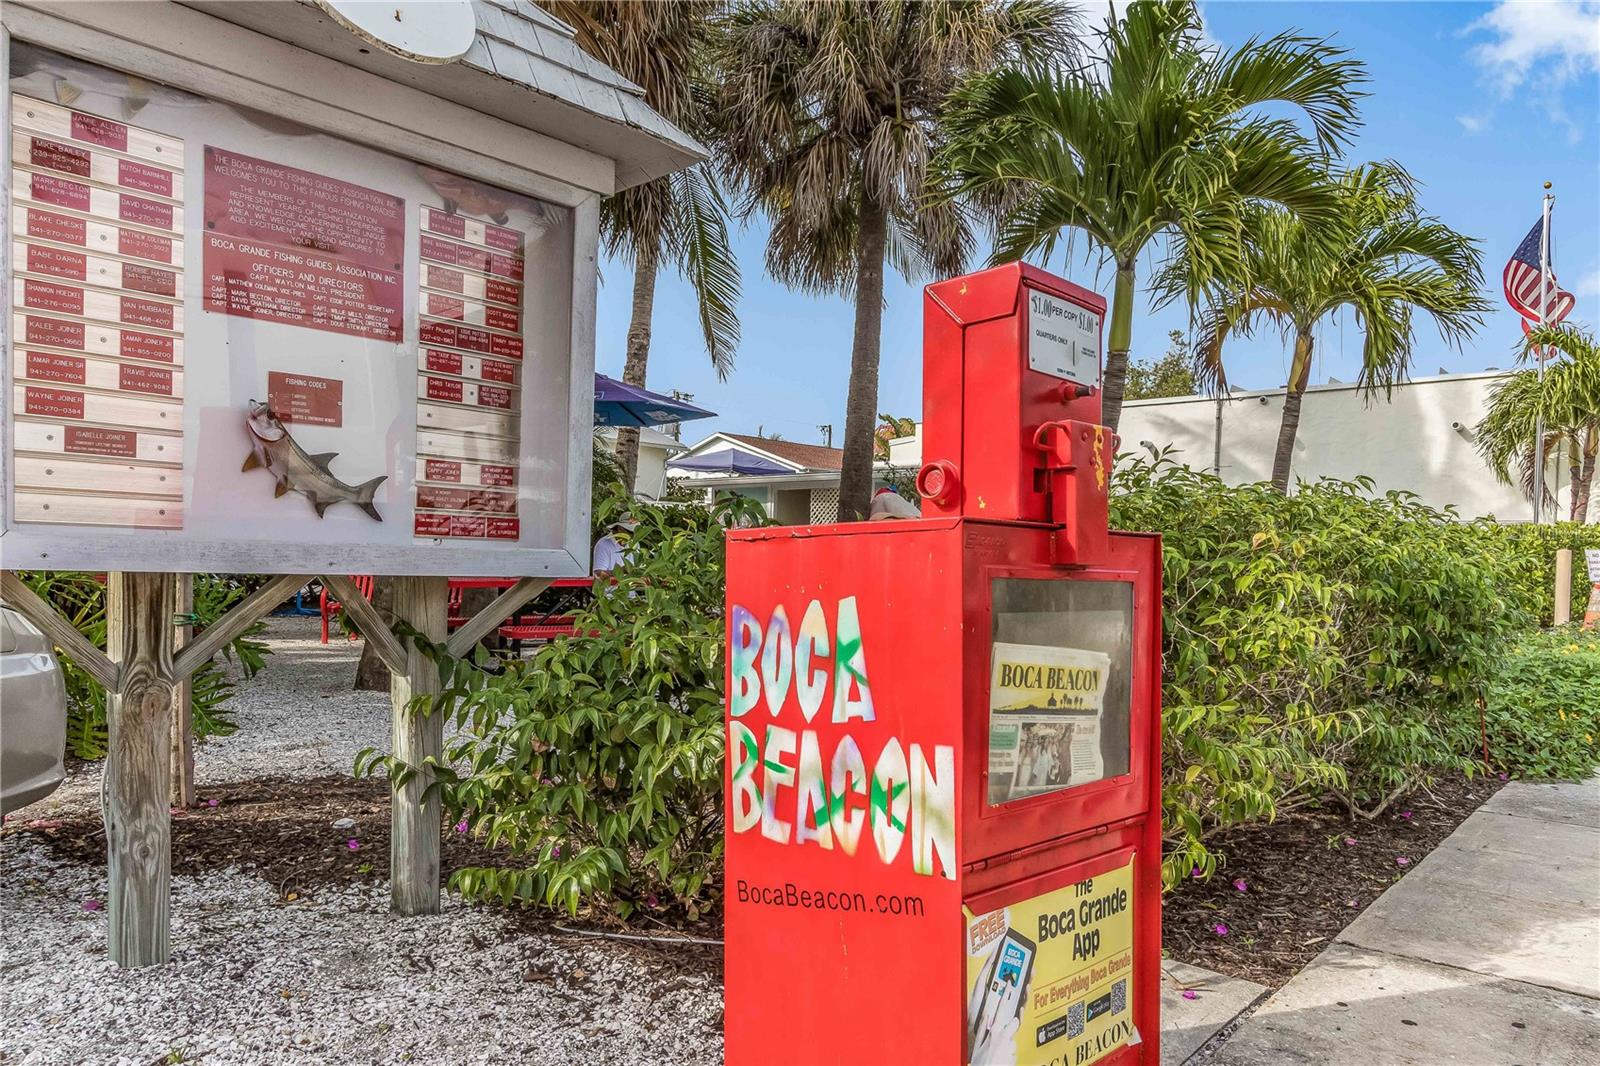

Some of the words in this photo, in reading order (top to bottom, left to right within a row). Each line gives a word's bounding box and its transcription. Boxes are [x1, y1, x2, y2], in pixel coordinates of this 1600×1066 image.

[33, 176, 56, 186] MARK
[59, 181, 89, 193] BECTON
[215, 155, 229, 165] THE
[231, 159, 253, 172] BOCA
[256, 165, 284, 179] GRANDE
[287, 173, 313, 187] FISHING
[214, 165, 257, 182] WELCOMES
[261, 178, 276, 187] YOU
[279, 181, 290, 190] TO
[292, 184, 308, 195] THIS
[310, 188, 338, 202] FAMOUS
[341, 197, 364, 209] FISHING
[121, 199, 140, 208] DAVID
[228, 198, 244, 208] AND
[247, 202, 296, 220] KNOWLEDGE
[298, 214, 343, 231] CONCERNING
[229, 190, 274, 206] REPRESENT
[279, 203, 302, 214] YEARS
[305, 208, 314, 216] OF
[318, 212, 343, 223] FISHING
[346, 219, 384, 233] EXPERIENCE
[240, 185, 254, 194] THE
[257, 190, 294, 204] MEMBERS
[310, 202, 325, 212] THIS
[328, 207, 378, 225] ORGANIZATION
[29, 213, 52, 224] BLAKE
[255, 212, 267, 221] WE
[270, 216, 307, 230] WELCOME
[311, 224, 324, 233] THE
[326, 229, 374, 245] OPPORTUNITY
[376, 241, 385, 250] TO
[230, 215, 246, 224] ADD
[250, 219, 296, 235] EXCITEMENT
[300, 229, 314, 239] AND
[317, 234, 336, 244] FOND
[340, 239, 373, 254] MEMORIES
[375, 248, 384, 256] TO
[291, 235, 312, 246] YOUR
[211, 238, 235, 250] BOCA
[238, 244, 271, 258] GRANDE
[274, 251, 303, 264] FISHING
[306, 258, 333, 271] GUIDES
[335, 265, 382, 281] ASSOCIATION
[228, 278, 253, 287] MATTHEW
[250, 273, 272, 283] CAPT.
[274, 278, 305, 290] WAYLON
[330, 289, 365, 300] PRESIDENT
[252, 262, 294, 279] OFFICERS
[298, 273, 316, 283] AND
[319, 276, 364, 292] DIRECTORS
[123, 301, 136, 309] VAN
[139, 304, 172, 314] HUBBARD
[231, 290, 248, 298] MARK
[231, 296, 248, 304] DAVID
[231, 303, 251, 312] WAYNE
[29, 321, 54, 330] KALEE
[57, 326, 82, 334] JOINER
[364, 314, 389, 323] DIRECTOR
[1031, 295, 1052, 318] $1.00
[1052, 306, 1063, 316] PER
[1064, 311, 1078, 322] COPY
[1079, 312, 1093, 334] $1.00
[1036, 329, 1057, 342] QUARTERS
[28, 356, 50, 365] LAMAR
[52, 359, 74, 367] JOINER
[124, 368, 145, 376] TRAVIS
[148, 371, 170, 379] JOINER
[28, 391, 54, 400] WAYNE
[57, 395, 83, 403] JOINER
[309, 381, 326, 389] CODES
[730, 595, 876, 724] BOCA
[1000, 664, 1042, 688] BOCA
[1046, 667, 1099, 691] BEACON
[729, 720, 957, 881] BEACON
[737, 879, 926, 917] BocaBeacon.com
[1074, 879, 1093, 897] The
[970, 910, 1005, 947] FREE
[1038, 908, 1075, 943] Boca
[1080, 887, 1127, 927] Grande
[972, 927, 1006, 954] DOWNLOAD
[1072, 928, 1100, 961] App
[1034, 993, 1048, 1010] For
[1050, 975, 1089, 1003] Everything
[1091, 966, 1107, 984] Boca
[1108, 952, 1131, 974] Grande
